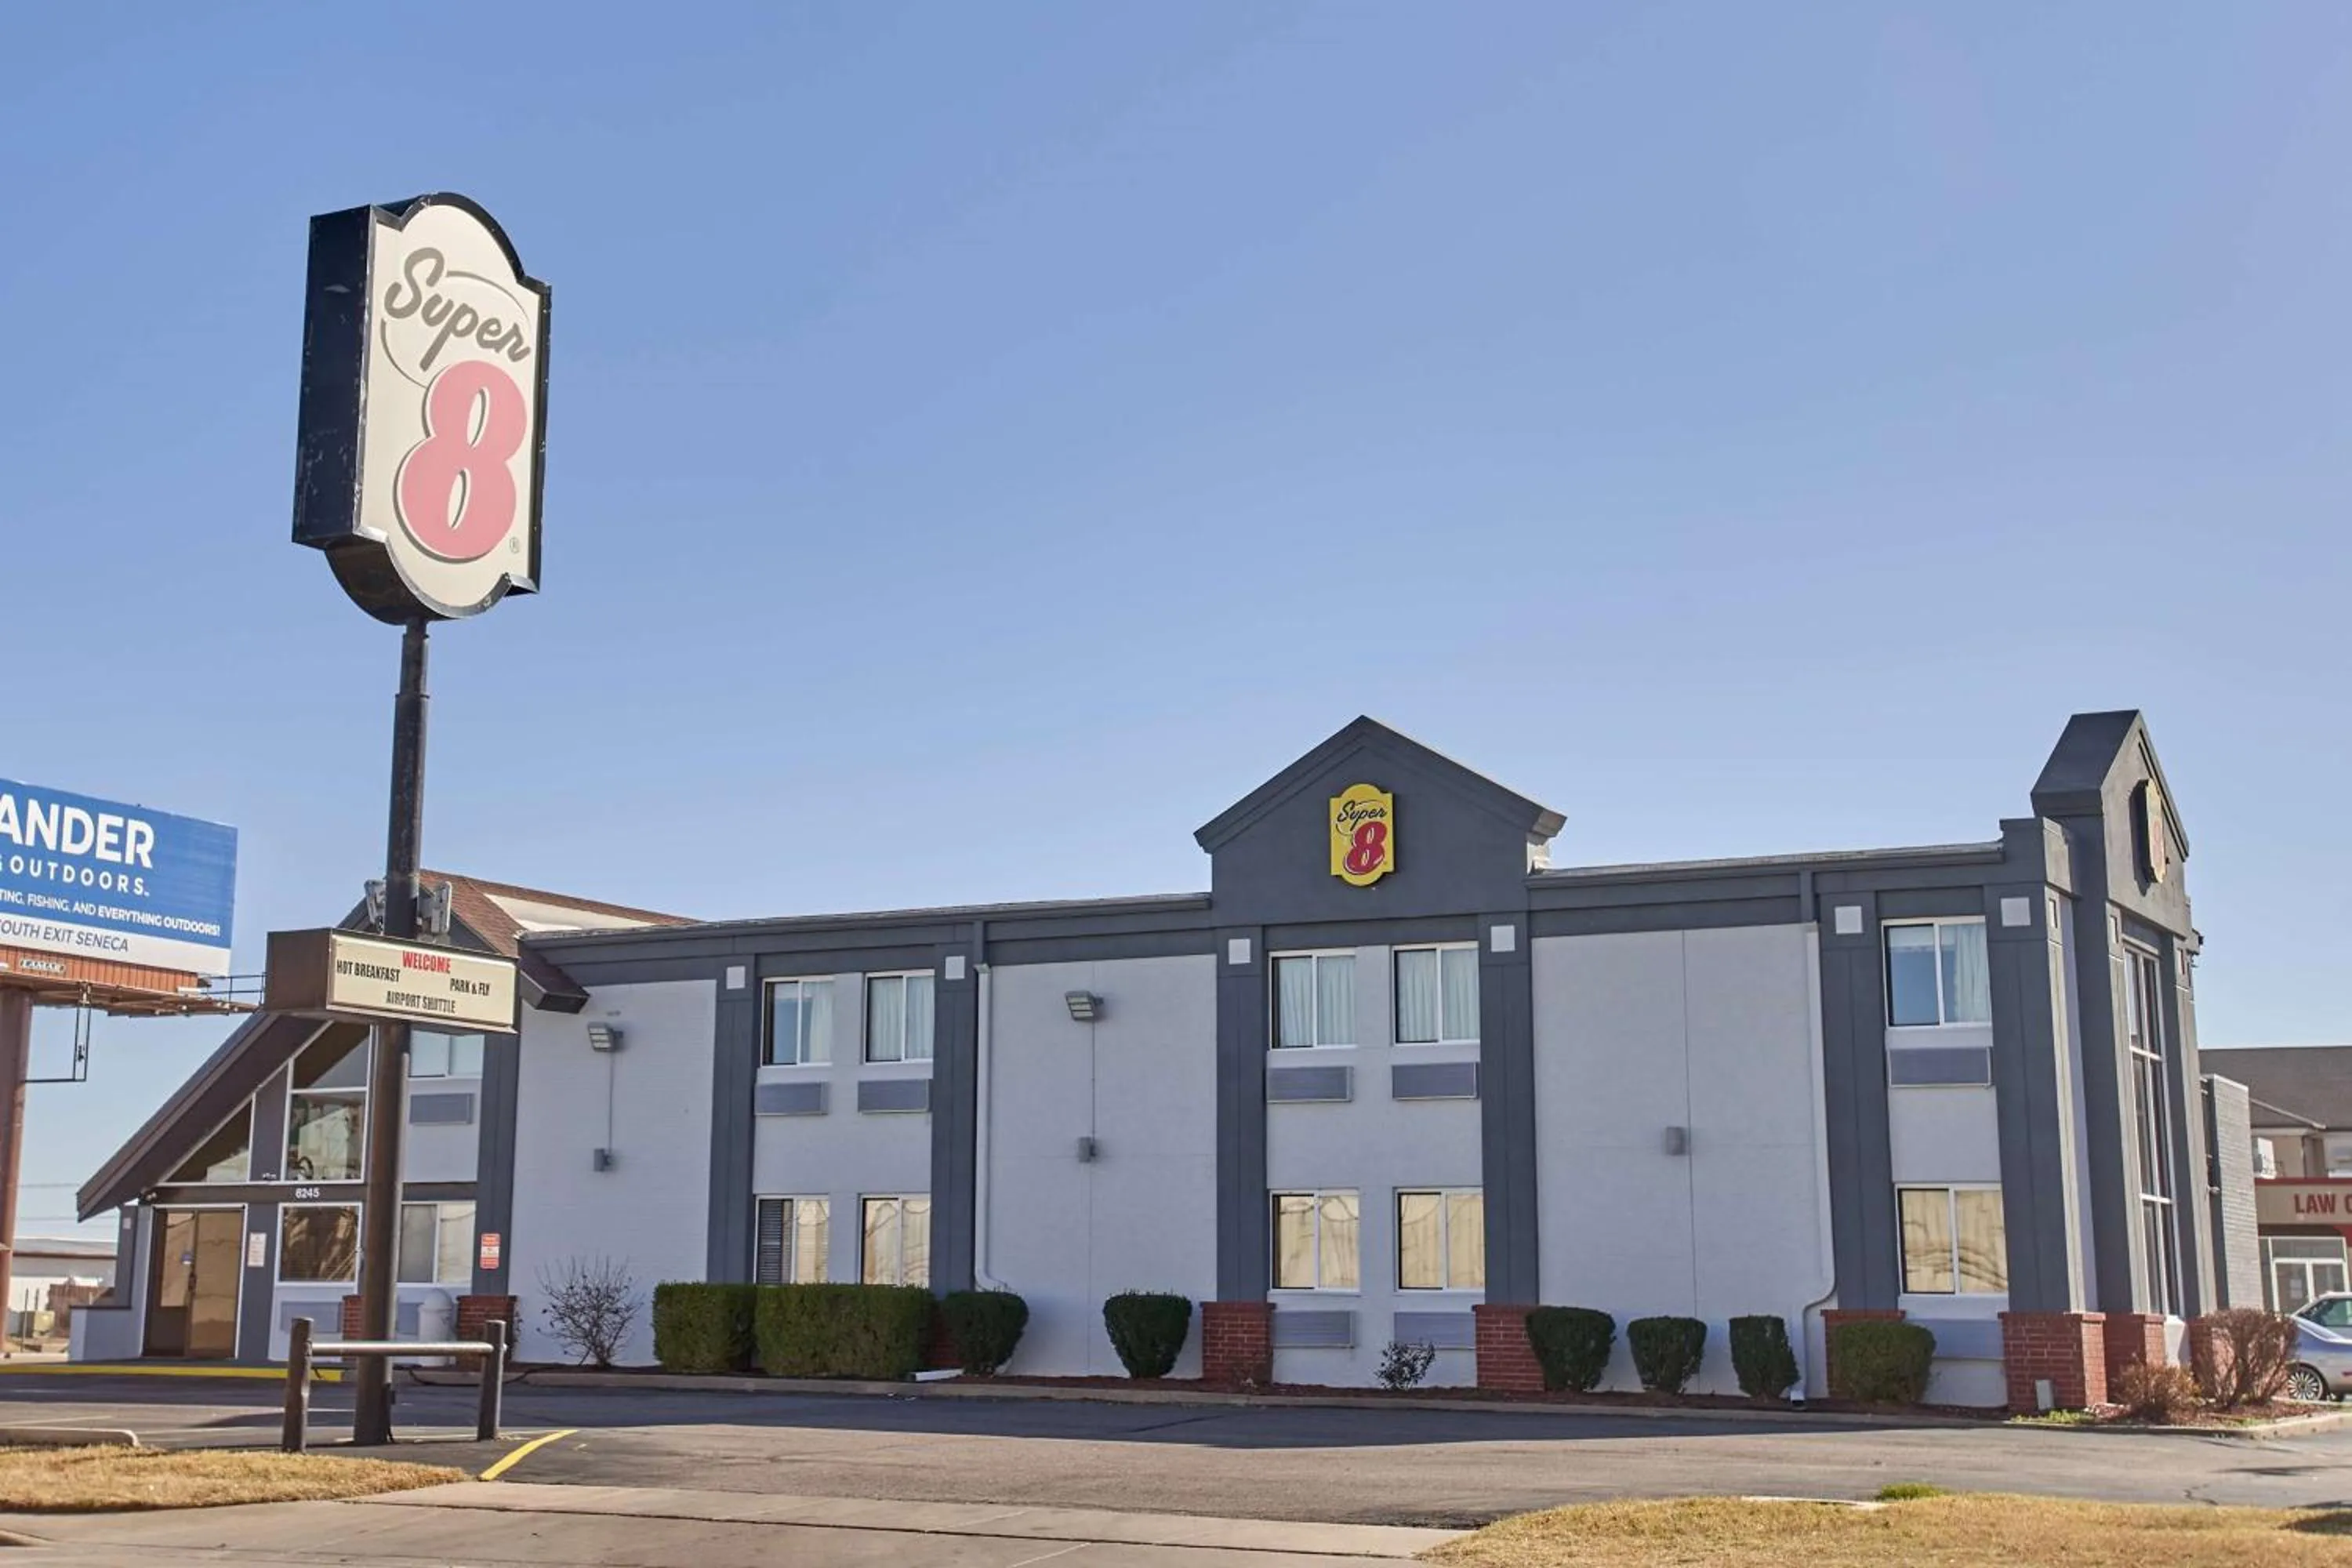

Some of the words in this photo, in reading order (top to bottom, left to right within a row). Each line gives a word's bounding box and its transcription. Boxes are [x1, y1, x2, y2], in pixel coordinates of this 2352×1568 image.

[384, 247, 532, 372] Super
[393, 360, 528, 564] 8
[0, 793, 154, 869] ANDER
[1337, 800, 1387, 831] Super
[1343, 821, 1388, 875] 8
[27, 893, 71, 913] FISHING,
[72, 900, 96, 916] AND
[98, 906, 162, 927] EVERYTHING
[163, 916, 220, 937] OUTDOORS!
[0, 918, 40, 938] OUTH
[43, 927, 74, 945] EXIT
[75, 931, 129, 953] SENECA
[336, 959, 353, 975] HOT
[354, 964, 401, 982] BREAKFAST
[402, 950, 452, 975] WELCOME
[386, 990, 421, 1010] AIRPORT
[423, 997, 456, 1014] SHUTTLE
[450, 978, 470, 994] PARK
[471, 982, 477, 994] &
[478, 982, 491, 996] FLY
[296, 1188, 321, 1199] 6245
[2293, 1193, 2336, 1214] LAW
